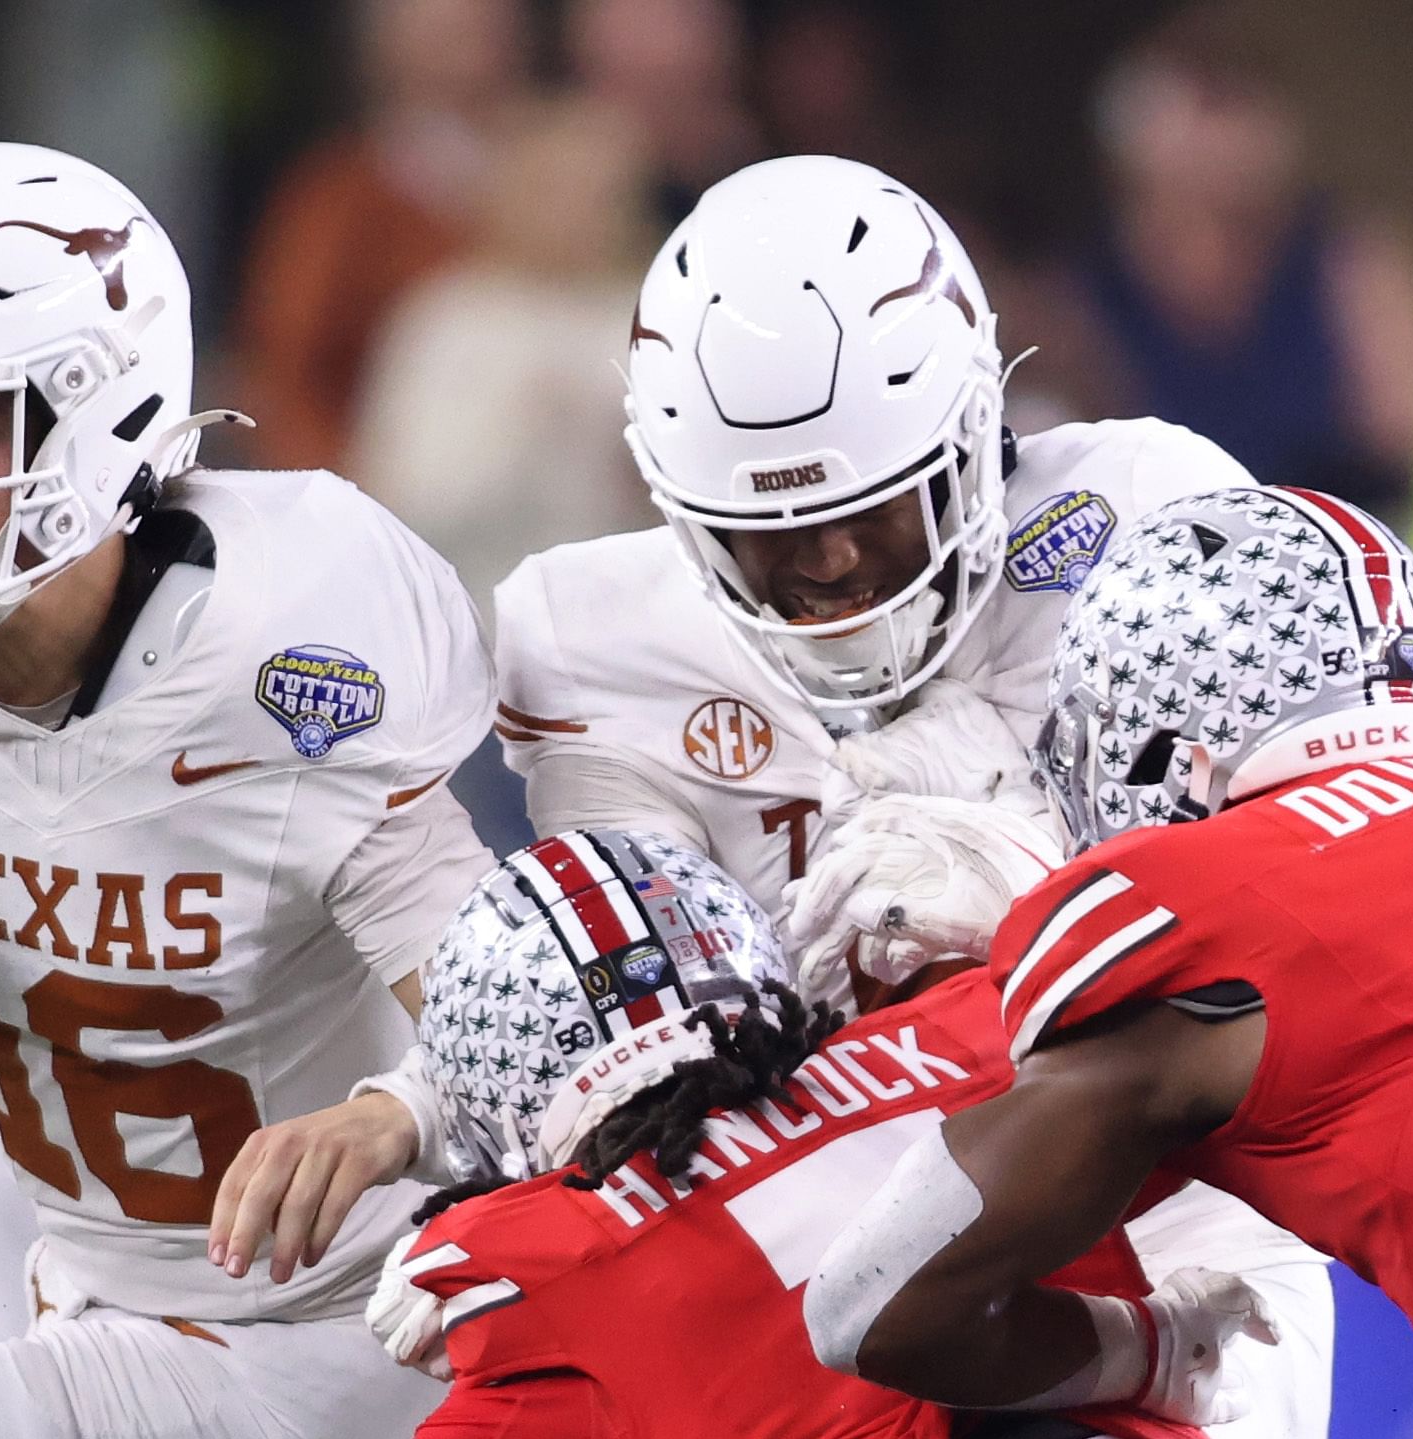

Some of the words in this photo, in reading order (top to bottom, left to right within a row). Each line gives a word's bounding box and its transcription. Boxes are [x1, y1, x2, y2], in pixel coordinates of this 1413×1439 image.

[750, 461, 827, 492] HORNS
[1008, 501, 1109, 581] COTTON
[1034, 530, 1096, 578] BOWL
[272, 655, 377, 684] GOODYEAR
[265, 670, 377, 720] COTTON
[284, 694, 353, 724] BOWL
[688, 702, 770, 776] SEC
[660, 906, 677, 926] 7
[595, 993, 618, 1010] CFP
[553, 1021, 595, 1056] 50
